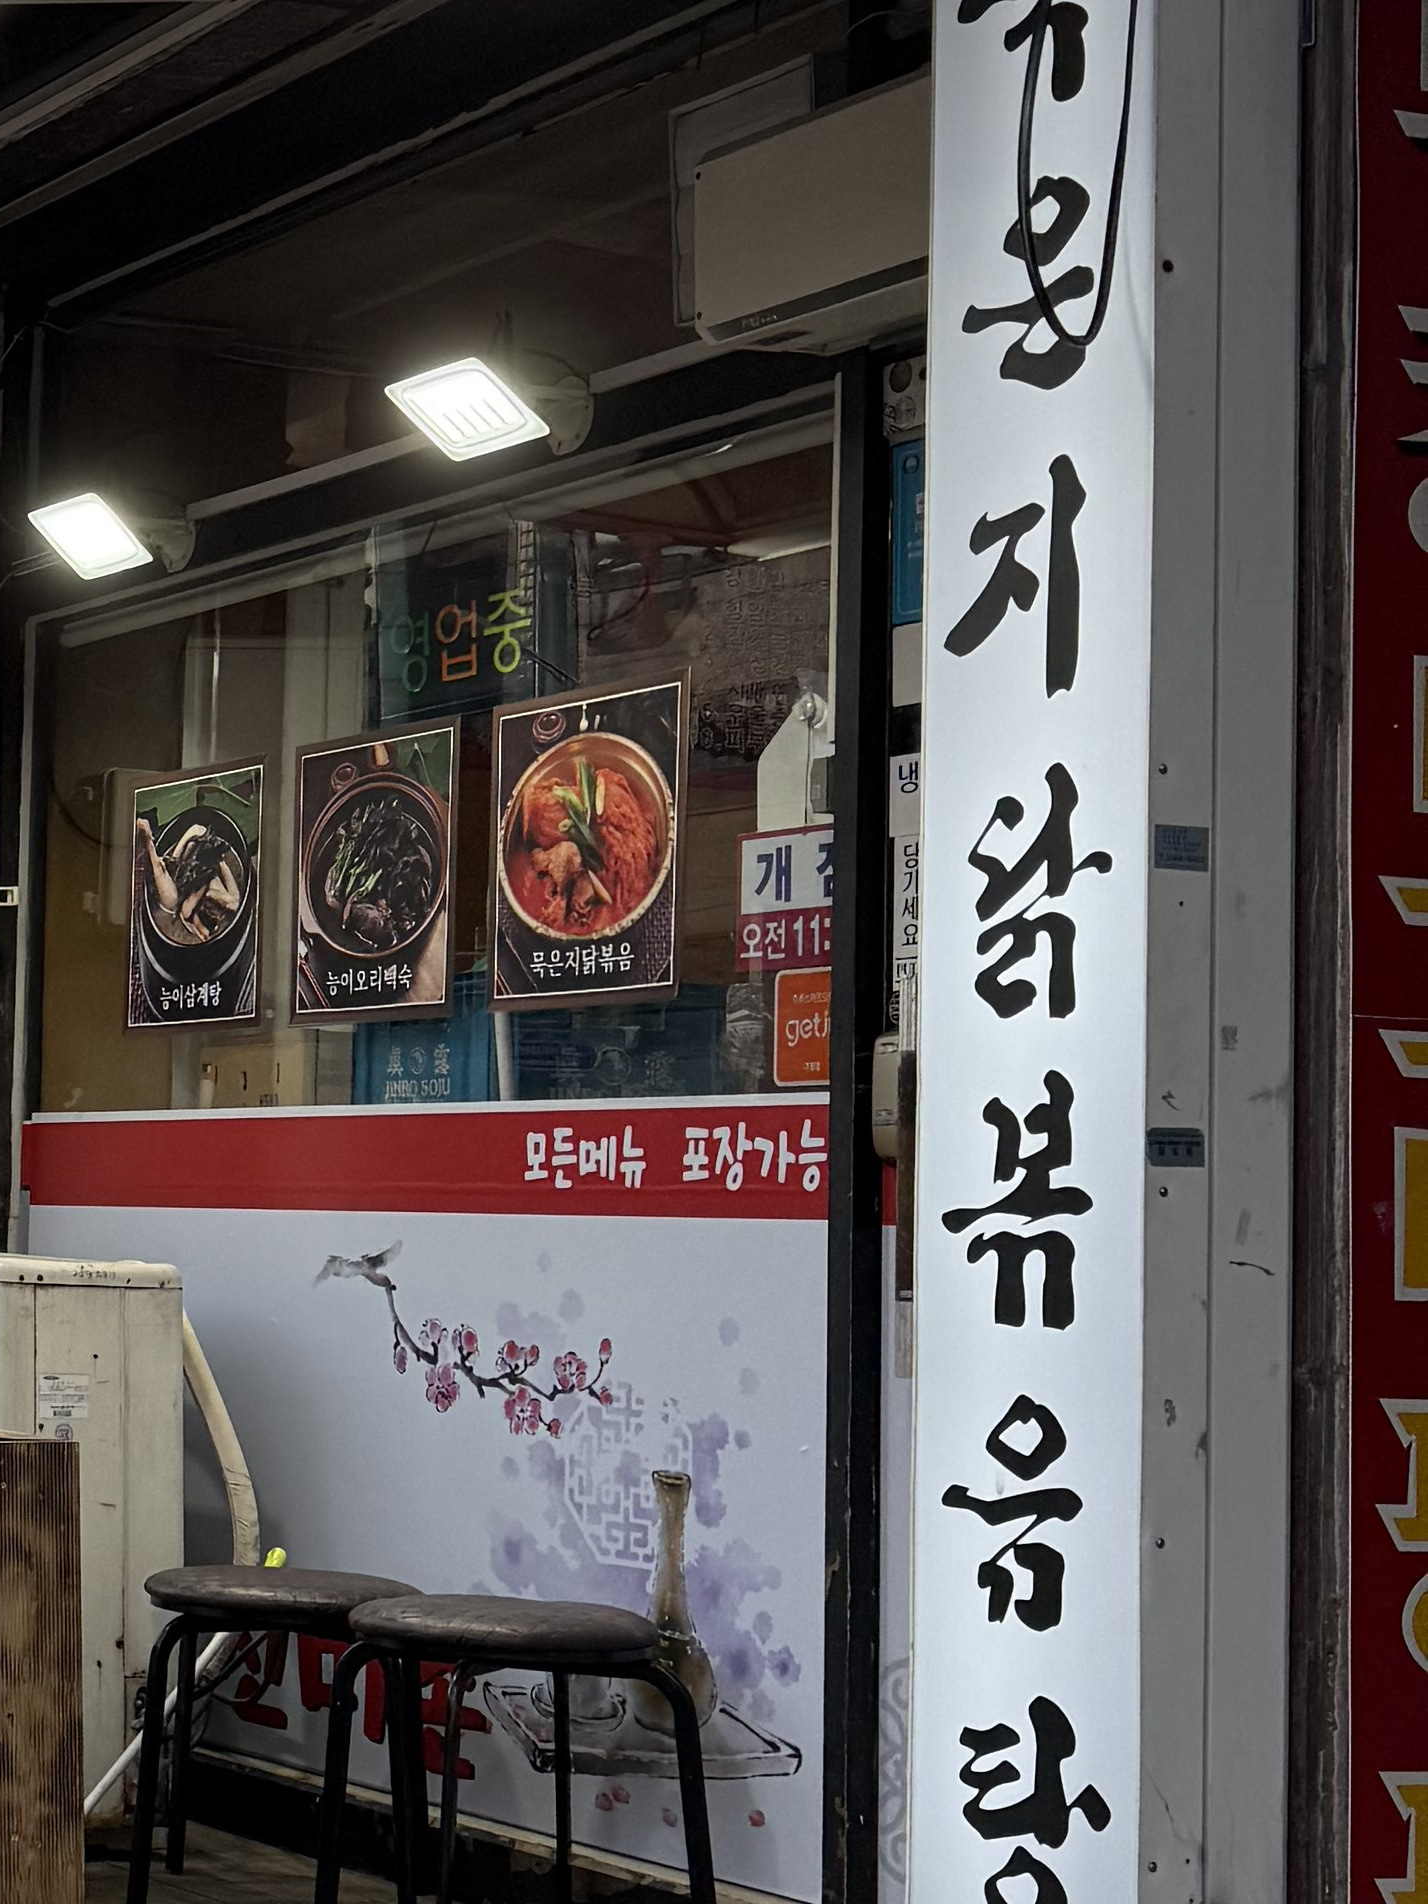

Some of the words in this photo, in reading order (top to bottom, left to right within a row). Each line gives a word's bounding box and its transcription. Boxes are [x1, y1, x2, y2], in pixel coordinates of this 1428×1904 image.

[391, 588, 533, 694] 영업중
[740, 919, 786, 962] 오전
[326, 963, 413, 997] 능이오리백숙
[529, 942, 637, 980] 묵은지닭볶음
[159, 980, 223, 1012] 능이삼계탕
[524, 1125, 648, 1190] 모든메뉴
[682, 1119, 830, 1192] 포장가능
